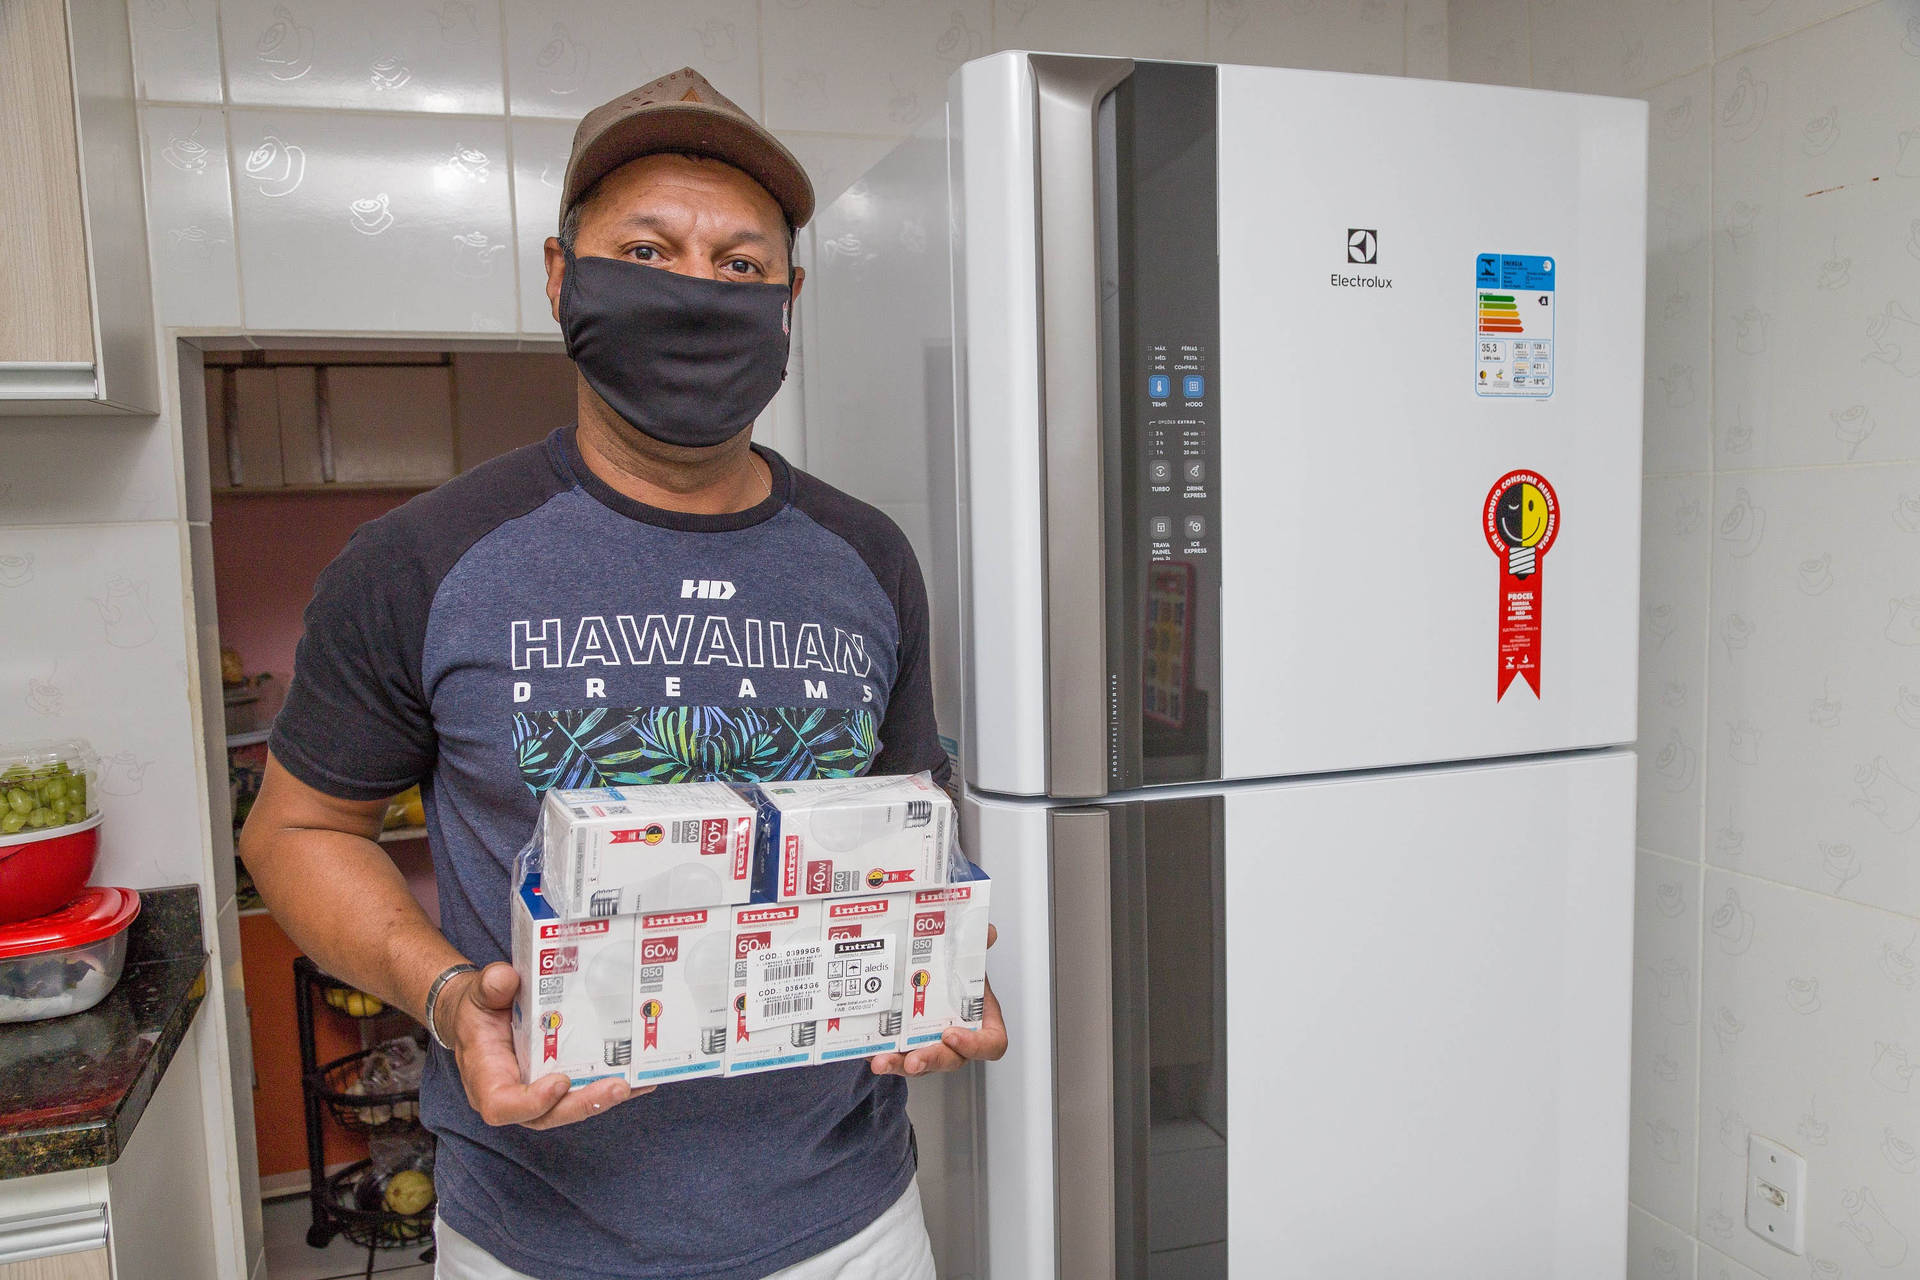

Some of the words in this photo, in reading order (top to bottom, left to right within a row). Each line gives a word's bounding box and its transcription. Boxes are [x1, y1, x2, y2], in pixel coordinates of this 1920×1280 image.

[1331, 273, 1392, 288] Electrolux
[1481, 343, 1497, 354] 35,3
[1501, 474, 1538, 489] CONSOME
[1538, 482, 1555, 512] MENOS
[1487, 488, 1501, 532] PRODUTO
[1537, 514, 1556, 550] ENERGIA
[1508, 592, 1533, 600] PROCEL
[511, 614, 873, 678] HAWAIIAN
[513, 676, 873, 703] DREAMS
[688, 821, 698, 842] 640
[785, 838, 798, 891] intral
[834, 872, 845, 891] 640
[742, 908, 796, 922] intral
[834, 902, 885, 915] intral
[648, 912, 704, 926] intral
[838, 941, 882, 952] intral
[913, 940, 932, 950] 850
[642, 967, 663, 977] 850
[864, 962, 889, 973] aledis
